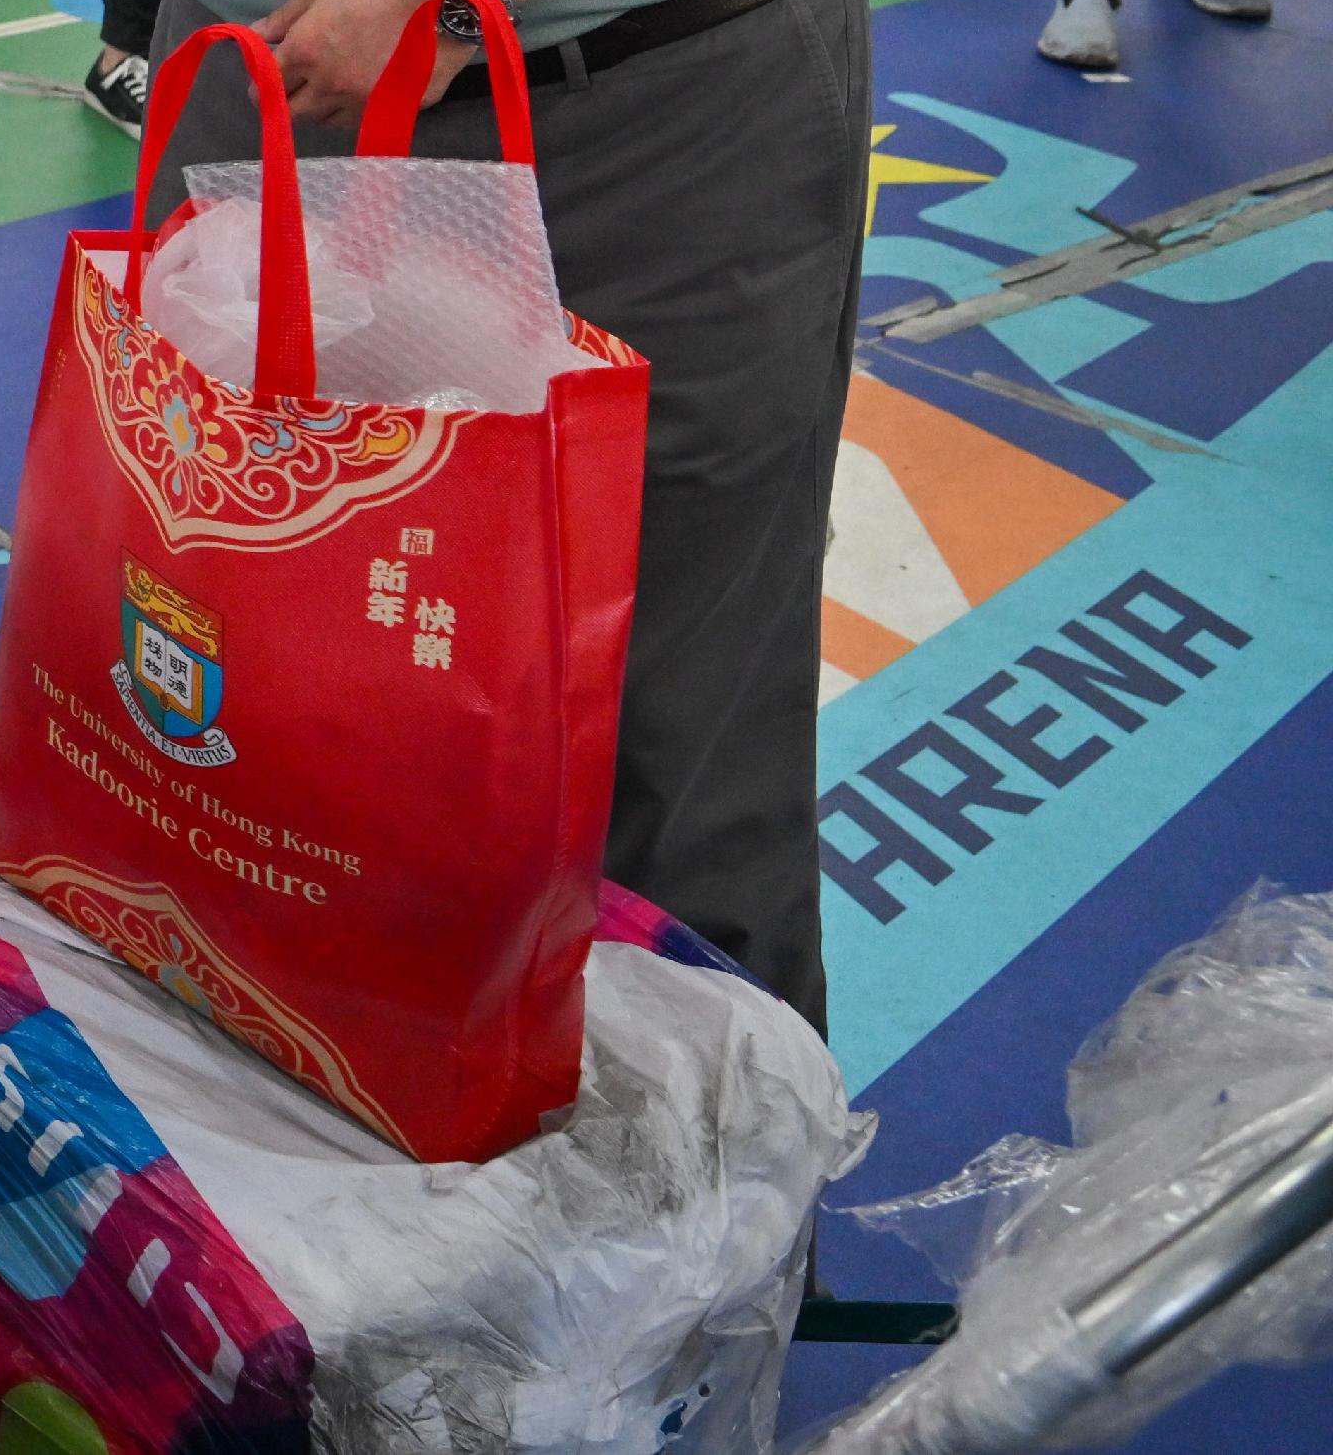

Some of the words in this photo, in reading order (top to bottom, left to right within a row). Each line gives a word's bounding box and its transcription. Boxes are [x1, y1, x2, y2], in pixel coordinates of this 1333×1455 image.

[33, 663, 65, 705] The
[69, 695, 166, 787] University
[170, 779, 197, 803] of
[202, 791, 273, 848] Hong
[282, 829, 362, 877] Kong
[46, 717, 178, 839] Kadoorie
[189, 827, 327, 905] Centre
[818, 568, 1253, 926] ARENA
